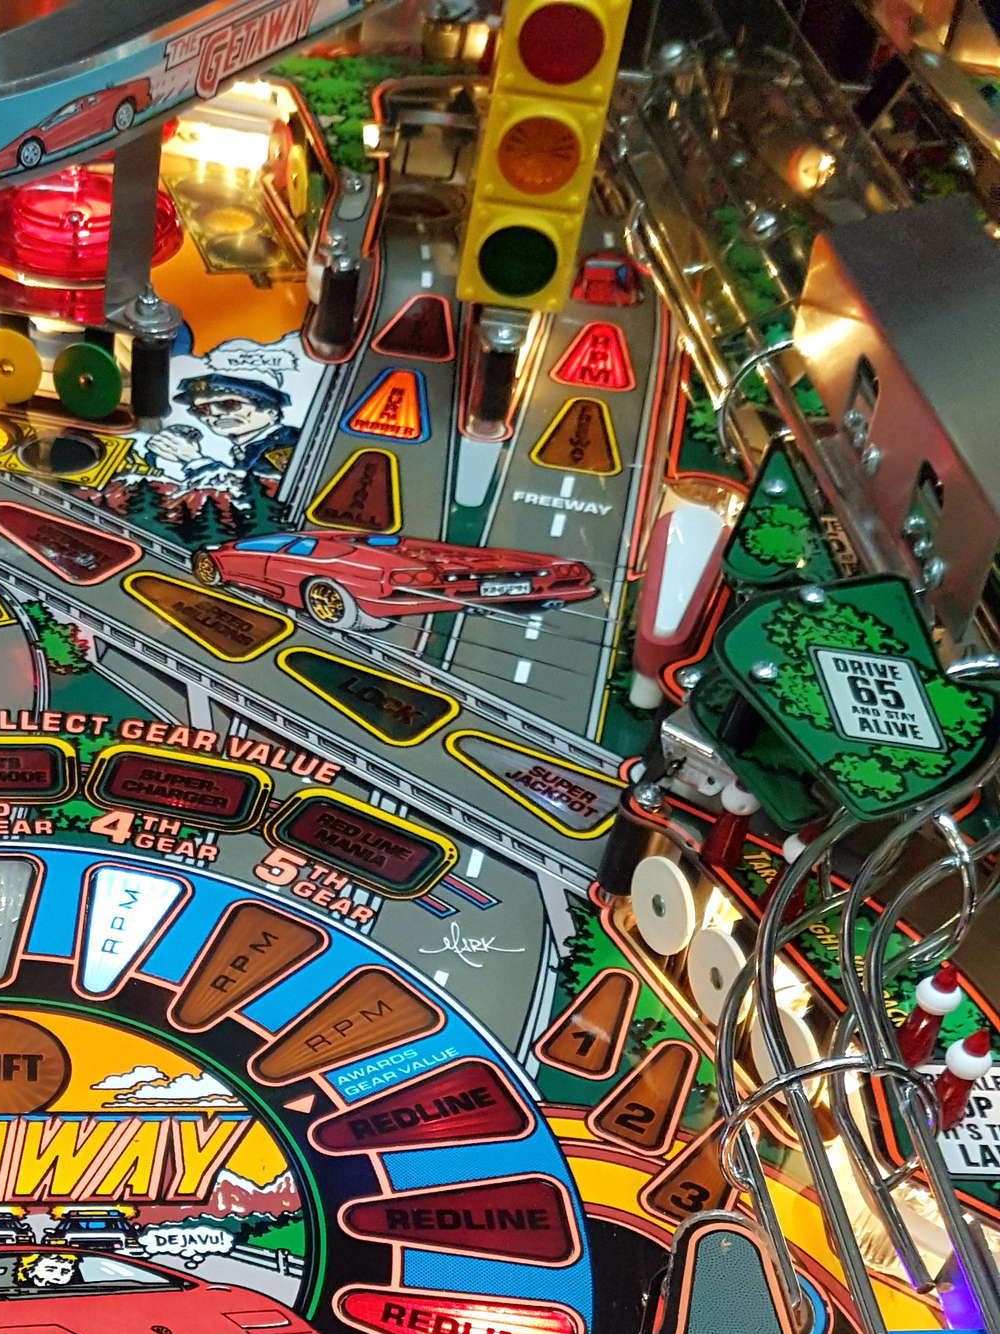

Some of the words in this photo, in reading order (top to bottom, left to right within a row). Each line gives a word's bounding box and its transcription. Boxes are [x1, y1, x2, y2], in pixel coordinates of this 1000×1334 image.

[167, 32, 199, 70] THE
[196, 0, 316, 98] GETAWAY
[513, 491, 613, 516] FREEWAY
[833, 656, 902, 680] DRIVE
[848, 676, 905, 708] 65
[851, 706, 882, 718] AND
[885, 710, 916, 723] STAY
[859, 718, 924, 740] ALIVE
[121, 719, 217, 751] GEAR
[228, 737, 342, 784] VALUE
[120, 780, 228, 810] CHARGER
[505, 769, 599, 819] JACKPOT
[528, 764, 599, 802] SUPER
[134, 835, 218, 862] GEAR
[315, 829, 389, 869] MANIA
[293, 880, 374, 925] GEAR
[101, 888, 143, 956] RPM
[211, 930, 279, 993] RPM
[305, 999, 394, 1053] RPM
[572, 1032, 607, 1056] 1
[336, 1048, 420, 1088] AWARDS
[344, 1070, 399, 1097] GEAR
[397, 1046, 460, 1083] VALUE
[349, 1085, 498, 1142] REDLINE
[615, 1103, 658, 1135] 2
[671, 1181, 710, 1211] 3
[385, 1207, 552, 1232] REDLINE
